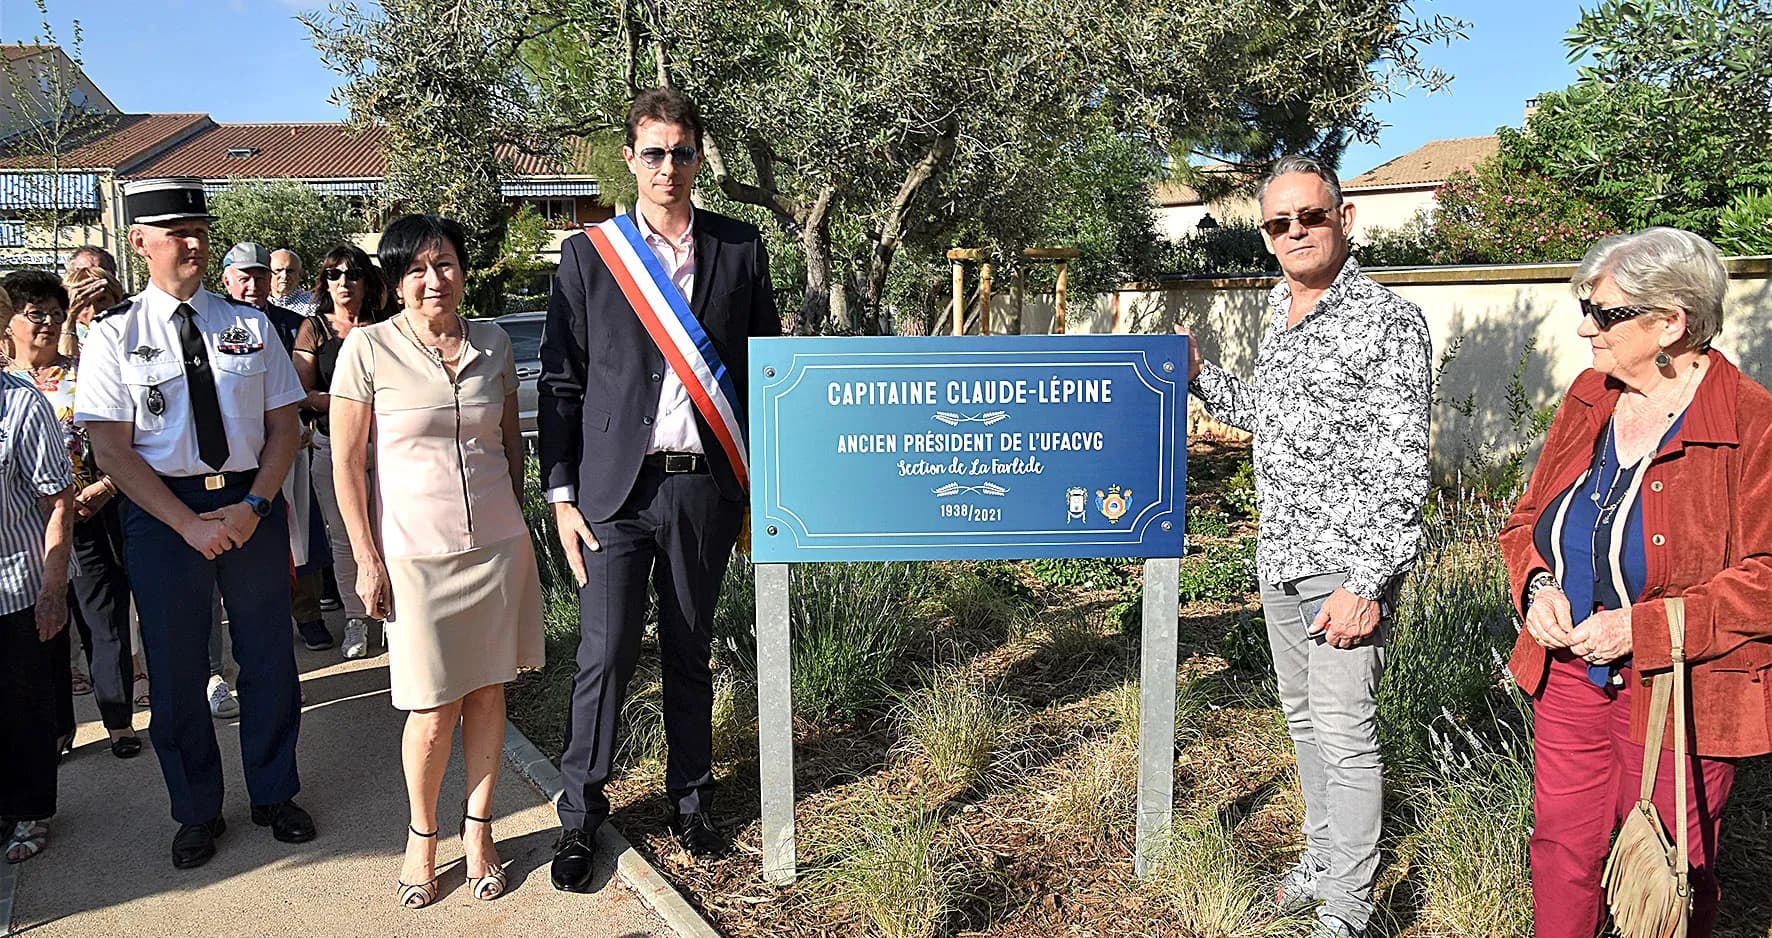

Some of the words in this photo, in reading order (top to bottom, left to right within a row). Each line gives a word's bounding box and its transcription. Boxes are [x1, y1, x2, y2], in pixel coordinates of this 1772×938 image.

[827, 382, 937, 406] CAPITAINE
[946, 376, 1112, 404] CLAUDE-LÉPINE
[837, 434, 897, 454] ANCIEN
[903, 430, 994, 453] PRÉSIDENT
[1000, 433, 1022, 452] DE
[1029, 431, 1103, 452] L’UFACVG
[896, 459, 947, 477] Section
[947, 456, 968, 475] de
[969, 459, 991, 476] La
[991, 455, 1045, 475] Farlède
[940, 503, 1002, 522] 1938/2021
